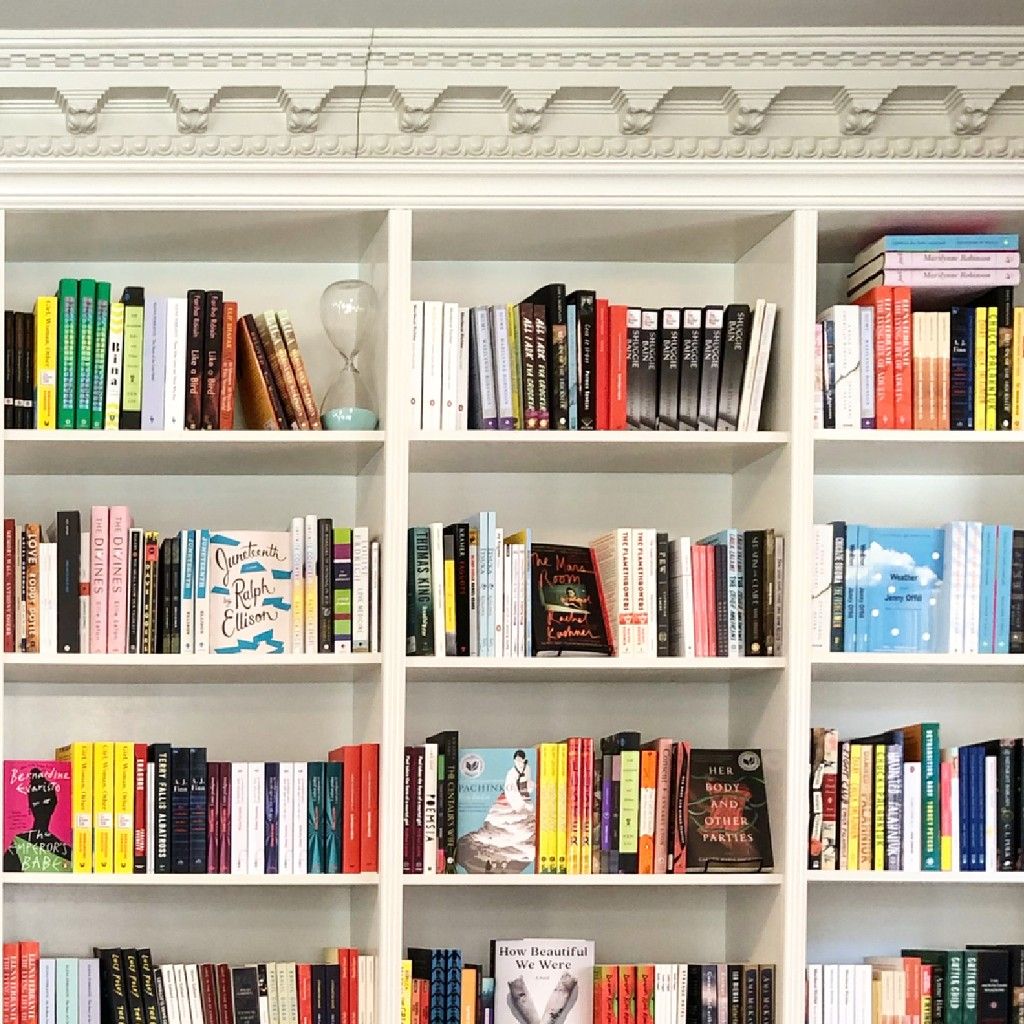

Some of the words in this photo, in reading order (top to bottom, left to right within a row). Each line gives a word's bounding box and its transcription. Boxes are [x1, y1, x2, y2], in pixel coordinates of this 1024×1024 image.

[728, 321, 736, 341] BAIN
[734, 312, 744, 350] SHUGGIE
[648, 332, 656, 370] SHUGGIE
[416, 533, 430, 574] THOMAS
[890, 573, 918, 582] Weather
[235, 578, 276, 603] Ralph
[418, 577, 431, 603] KING
[222, 607, 278, 638] Ellison
[158, 753, 167, 778] TERRY
[709, 766, 733, 776] HER
[10, 768, 71, 784] Bernardine
[158, 781, 167, 809] FALLIS
[705, 782, 742, 792] BODY
[710, 800, 739, 809] AND
[704, 817, 749, 826] OTHER
[158, 813, 167, 858] ALBATROSS
[702, 832, 753, 843] PARTIES
[21, 855, 62, 870] BABE
[499, 946, 526, 957] How
[530, 946, 587, 957] Beautiful
[515, 959, 536, 970] We
[539, 959, 572, 970] Were
[116, 1006, 124, 1020] THE
